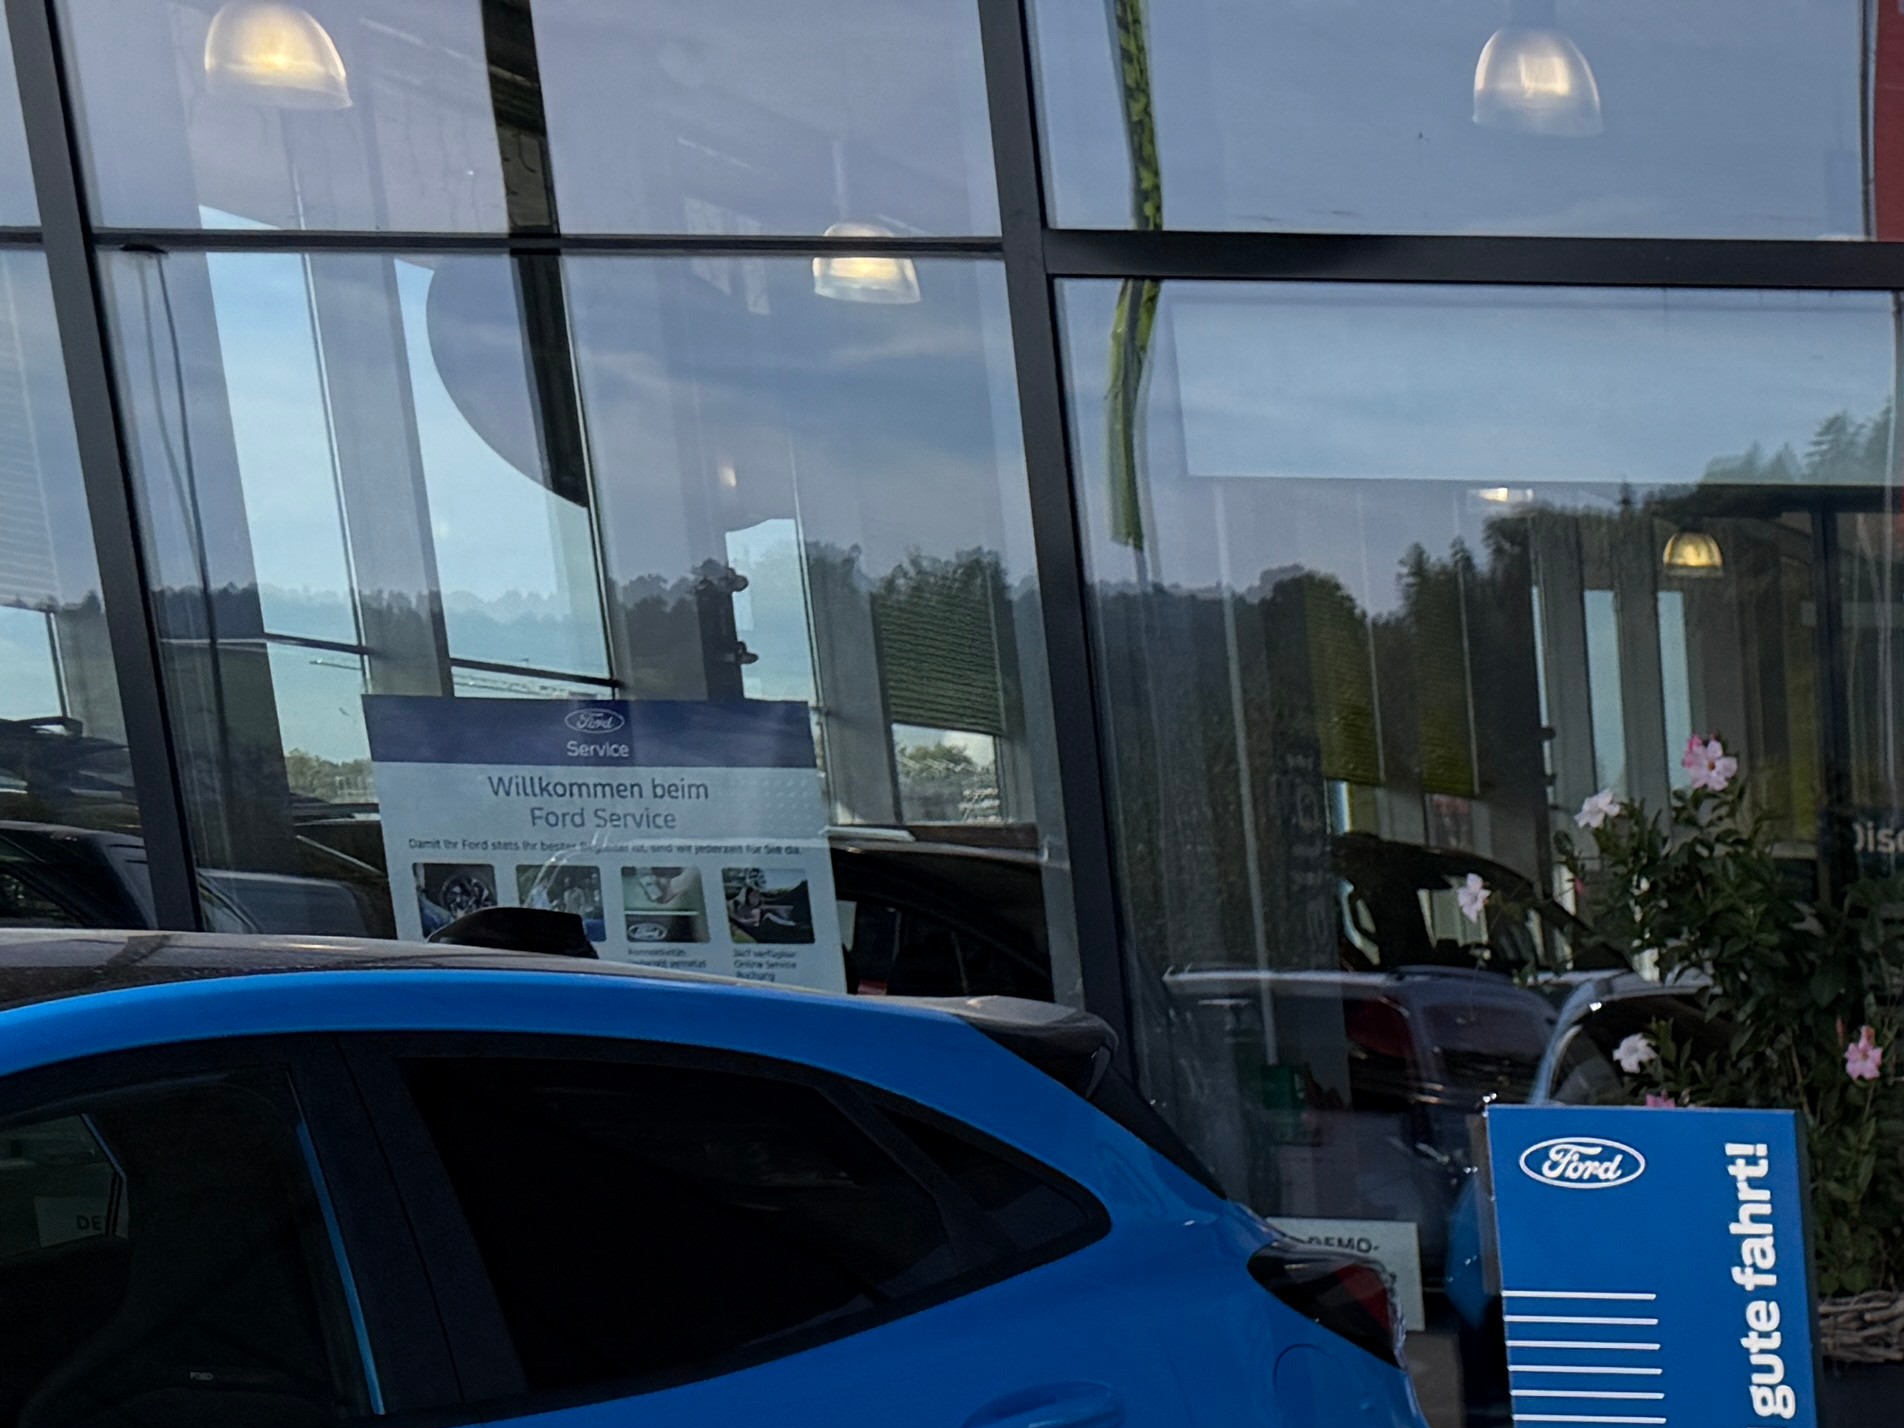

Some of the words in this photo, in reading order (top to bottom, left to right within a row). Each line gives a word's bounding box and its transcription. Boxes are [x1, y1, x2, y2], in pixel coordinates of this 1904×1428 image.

[566, 740, 630, 758] Service
[487, 776, 643, 800] Willkommen
[652, 777, 709, 800] beim
[530, 807, 585, 829] Ford
[593, 808, 676, 830] Service
[461, 839, 488, 850] Ford
[1540, 1145, 1623, 1183] Ford
[1724, 1142, 1778, 1292] fahrt!
[1739, 1299, 1797, 1421] gute
